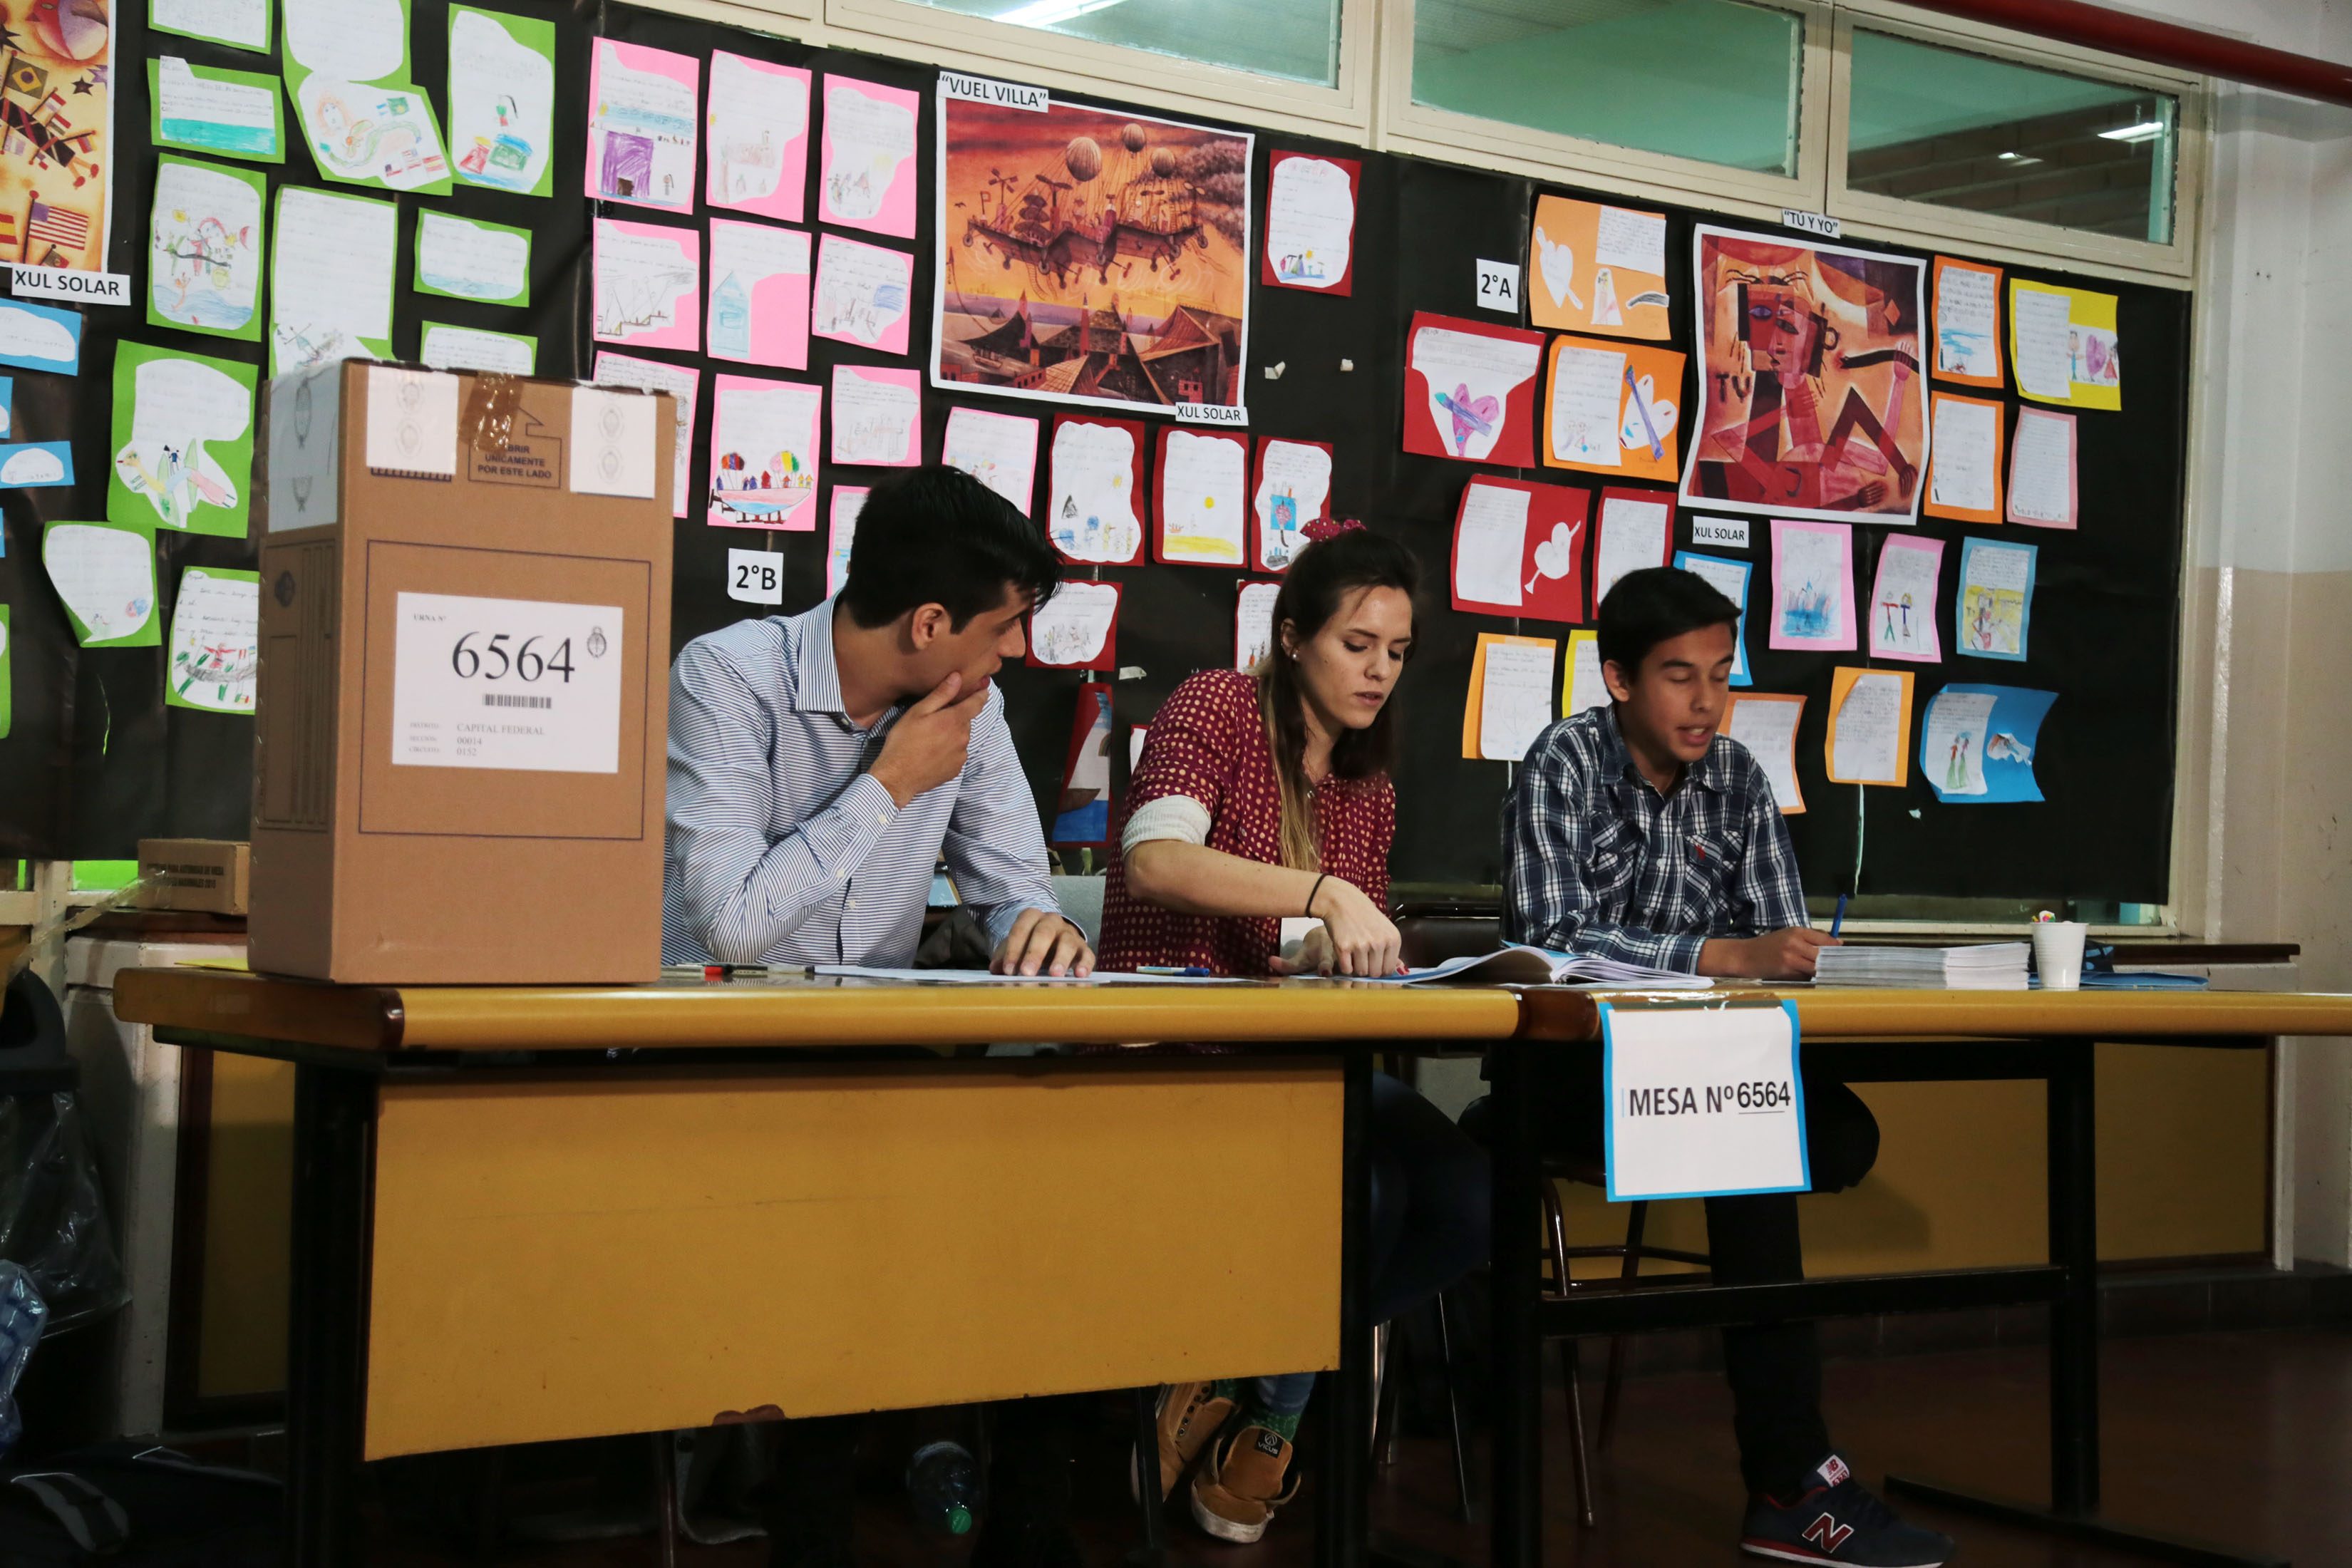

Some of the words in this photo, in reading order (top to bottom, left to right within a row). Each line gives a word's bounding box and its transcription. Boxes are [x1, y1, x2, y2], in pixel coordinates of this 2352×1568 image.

[1807, 215, 1815, 229] Y
[15, 269, 52, 289] XUL
[58, 275, 120, 296] SOLAR
[1177, 405, 1200, 418] XUL
[1203, 407, 1242, 421] SOLAR
[478, 465, 497, 474] POR
[500, 467, 524, 477] ESTE
[526, 470, 552, 479] LADO
[1694, 526, 1712, 538] XUL
[1715, 527, 1745, 541] SOLAR
[413, 613, 435, 621] URNA
[452, 631, 575, 683] 6564
[457, 723, 499, 733] CAPITAL
[501, 725, 545, 735] FEDERAL
[1629, 1087, 1698, 1117] MESA
[1258, 1441, 1279, 1455] VICUS
